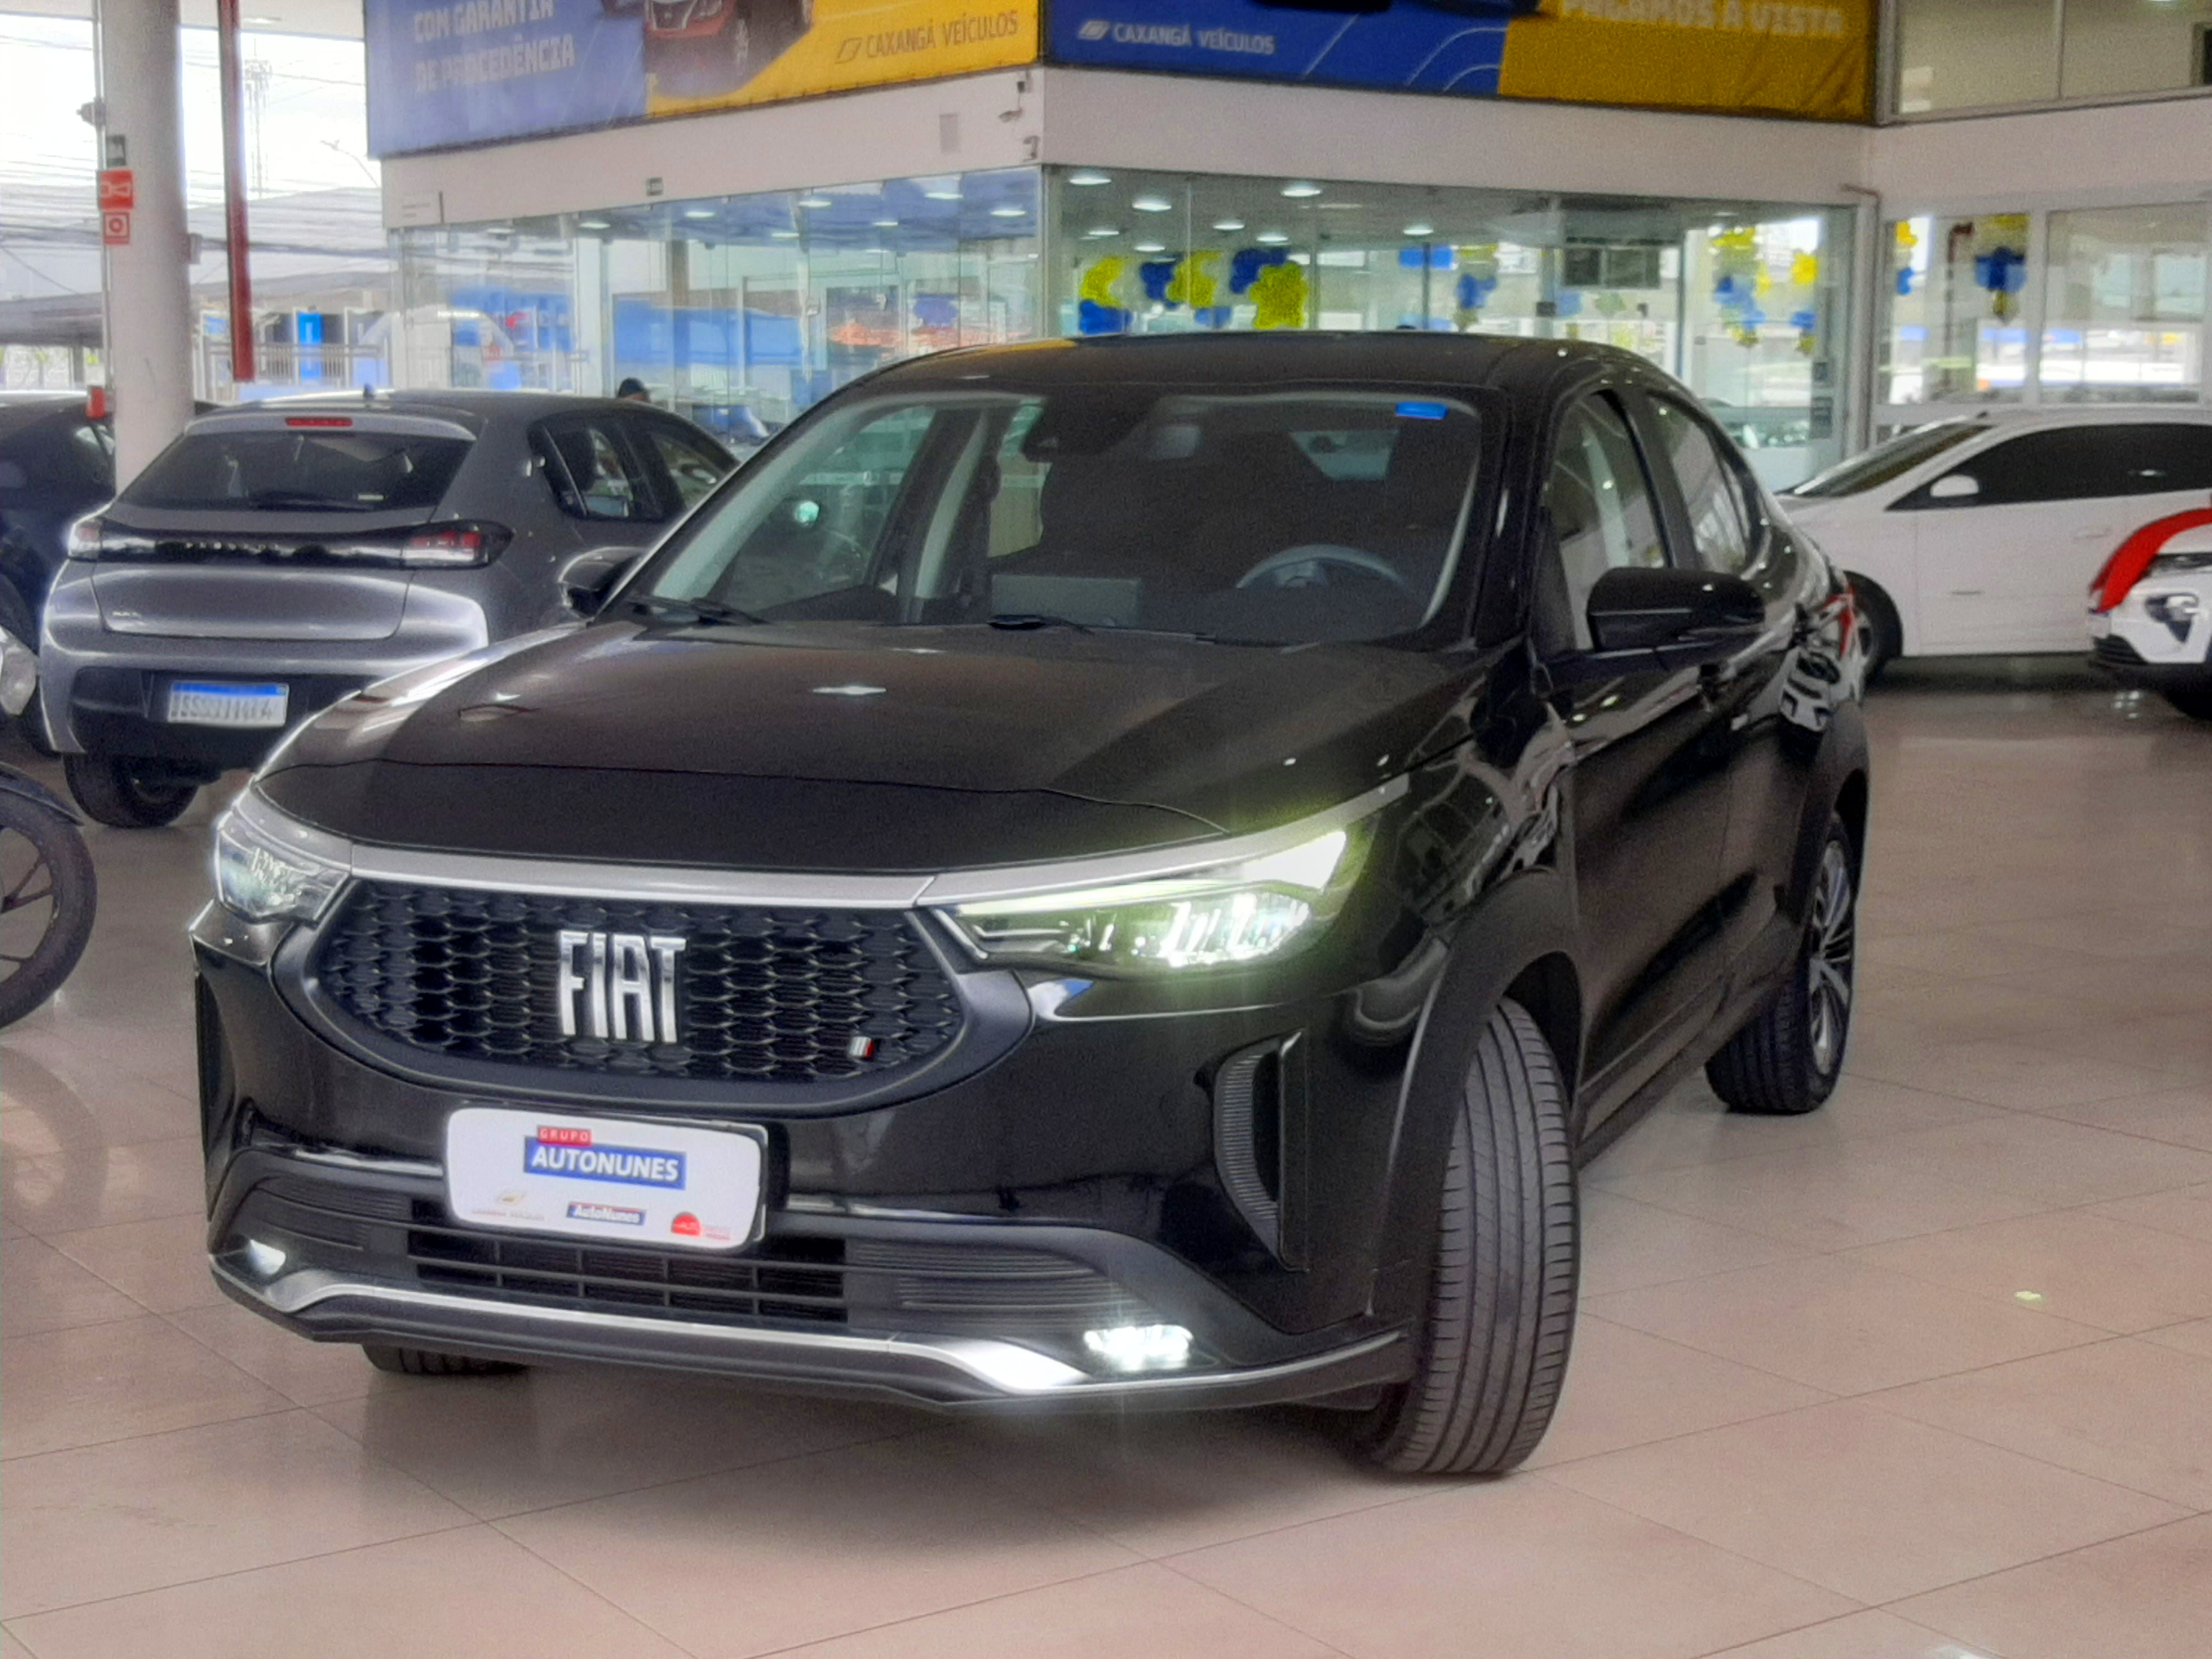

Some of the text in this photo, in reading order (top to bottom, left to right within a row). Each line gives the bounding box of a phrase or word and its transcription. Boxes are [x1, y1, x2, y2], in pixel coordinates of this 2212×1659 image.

[866, 10, 1018, 58] CAXANGÁ VEÍCULOS
[1113, 24, 1275, 55] CAXANGÁ VEÍCULOS
[560, 930, 686, 1044] FIAT
[539, 1128, 589, 1142] GRUPO
[531, 1145, 679, 1182] AUTONUNES
